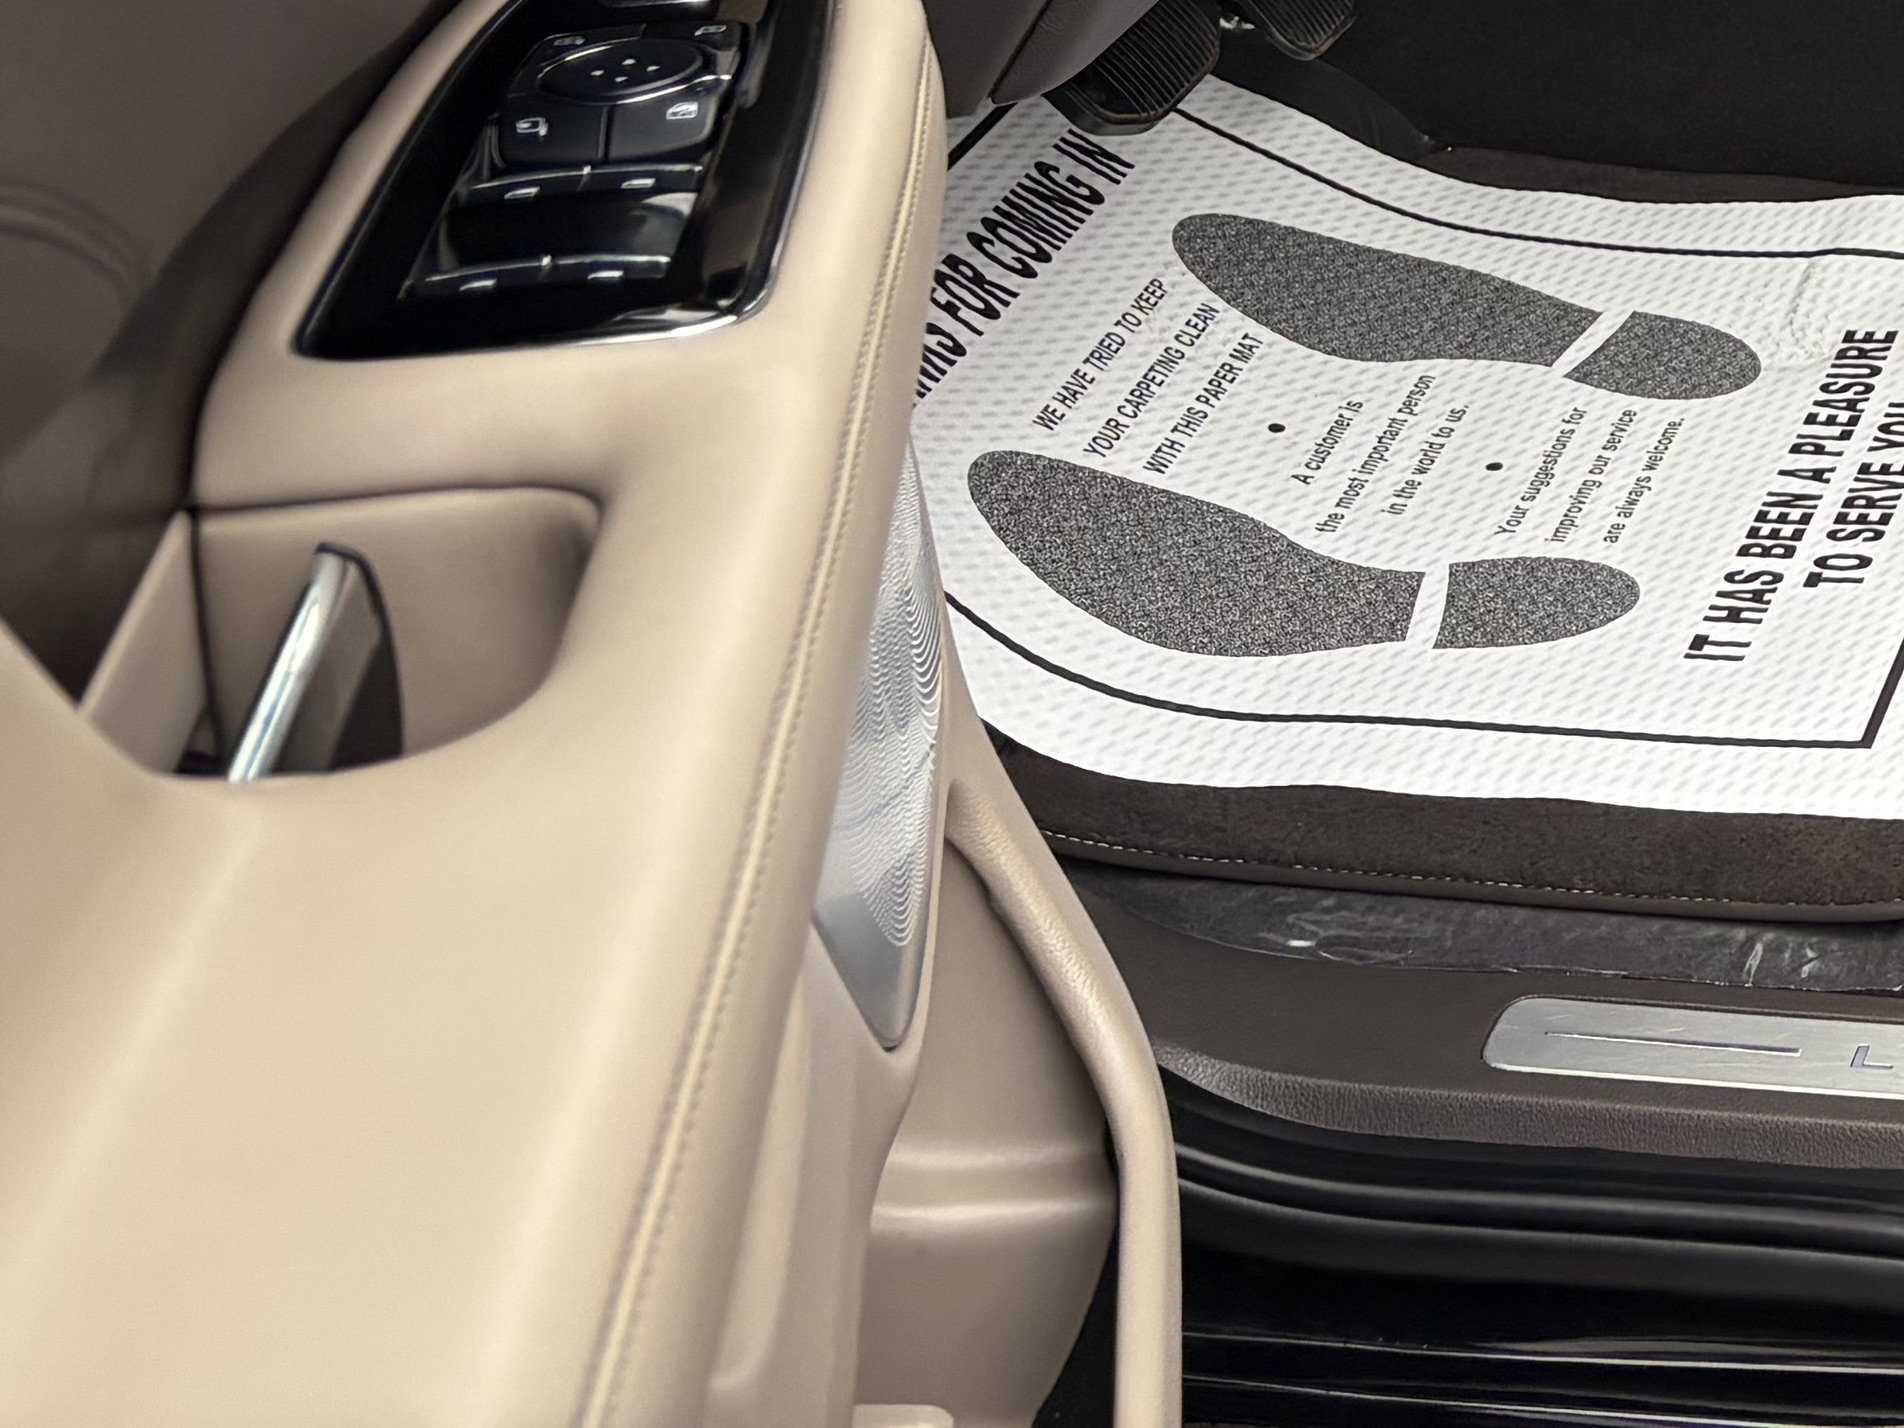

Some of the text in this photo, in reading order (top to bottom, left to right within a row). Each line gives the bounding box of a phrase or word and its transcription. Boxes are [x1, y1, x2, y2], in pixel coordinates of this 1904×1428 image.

[966, 161, 1105, 279] COMING
[1053, 128, 1135, 185] IN
[930, 253, 1020, 336] FOR
[1032, 278, 1168, 431] WE HAVE TRIED TO KEEP
[1083, 302, 1220, 458] YOUR CARPETING CLEAN
[1142, 333, 1264, 475] WITH THIS PAPER MAT
[1291, 400, 1364, 485] A customer is
[1315, 374, 1436, 533] the most important person
[1381, 404, 1470, 515] in the world to us.
[1494, 406, 1588, 535] Your suggestions for
[1544, 409, 1638, 542] improving our service
[1603, 417, 1686, 544] are always welcome.
[1683, 329, 1900, 661] IT HAS BEEN A PLEASURE
[1802, 553, 1874, 588] TO
